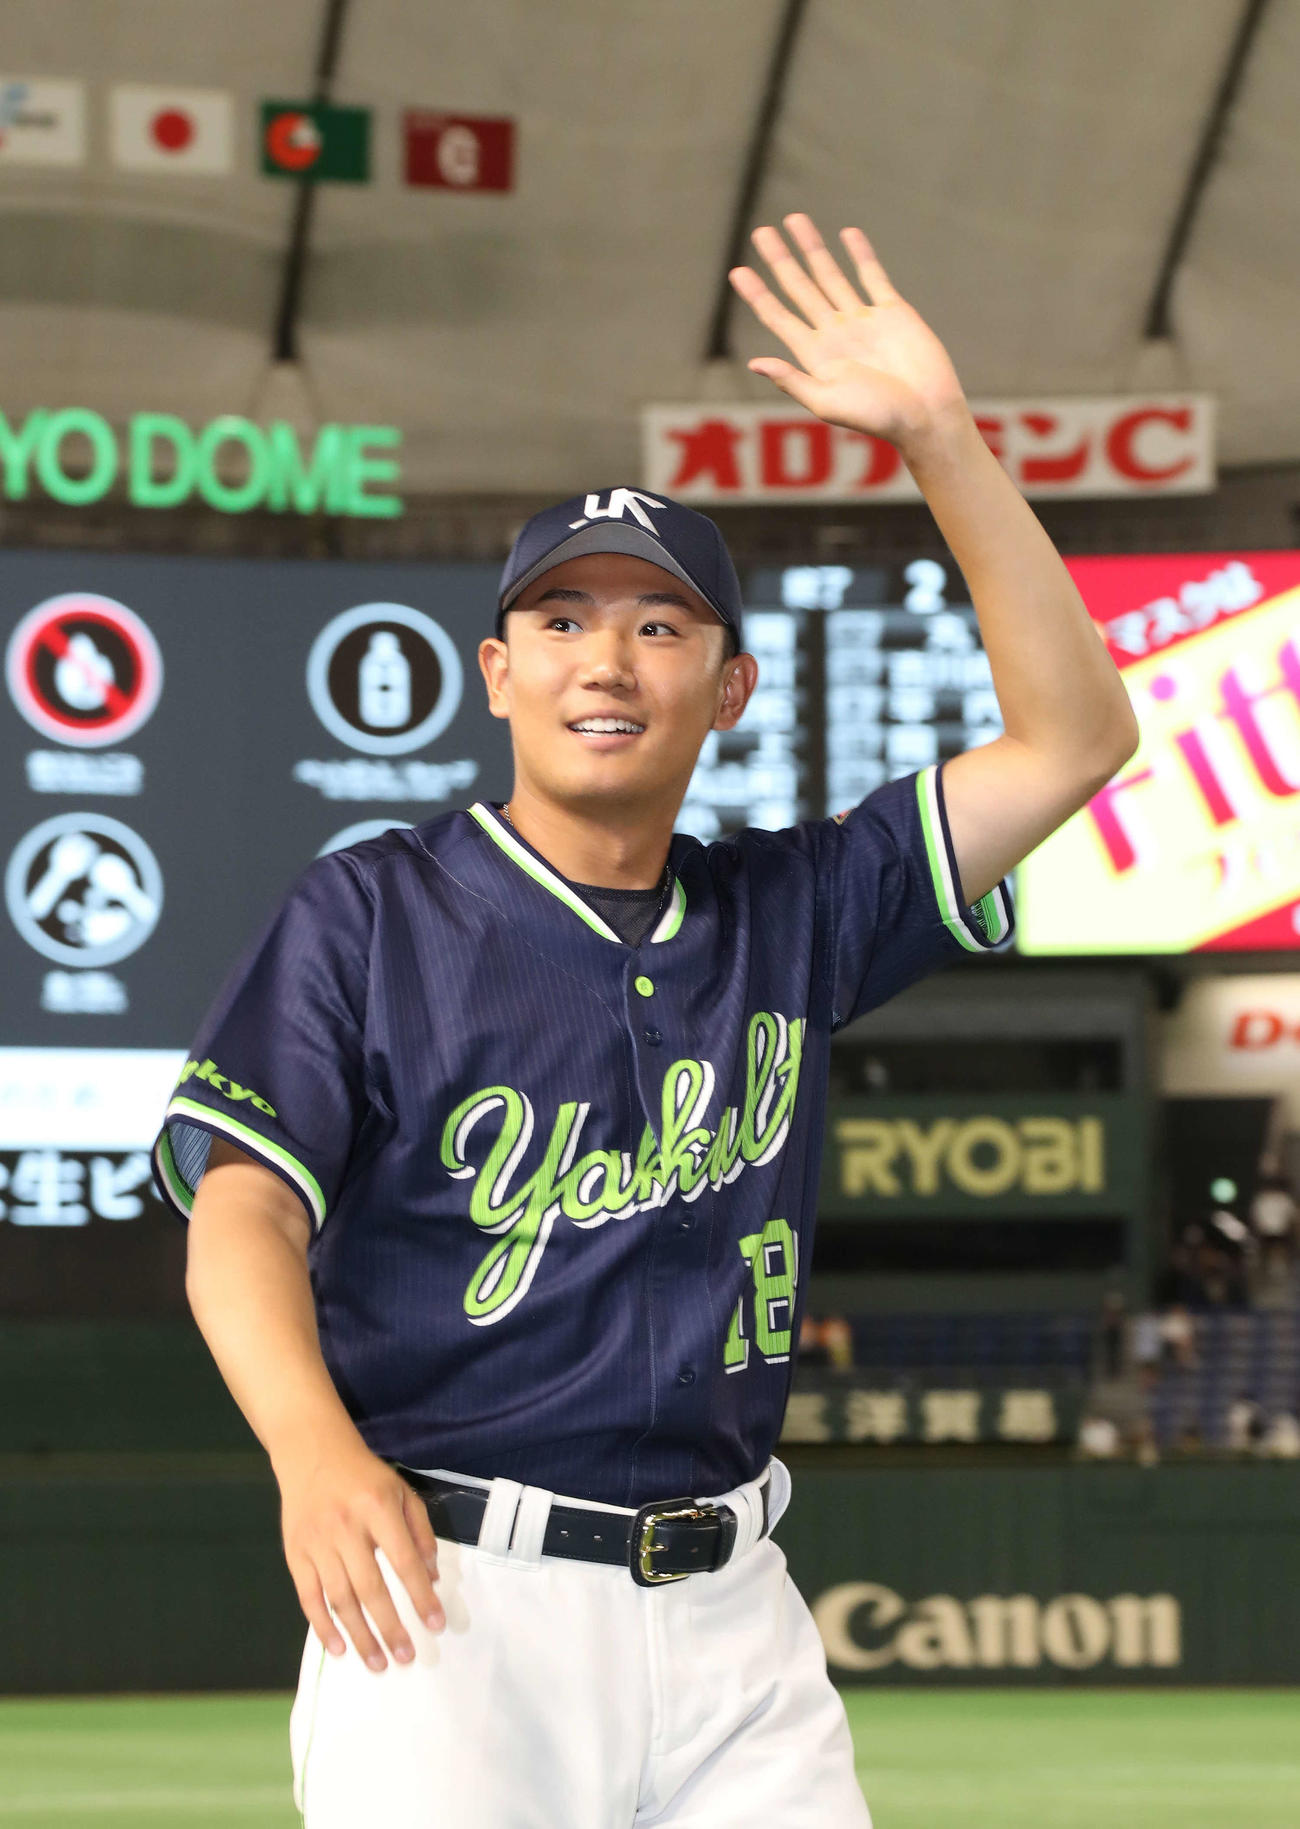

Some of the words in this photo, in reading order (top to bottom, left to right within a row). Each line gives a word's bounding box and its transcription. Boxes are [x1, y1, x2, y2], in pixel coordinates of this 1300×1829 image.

[129, 411, 404, 518] DOME
[835, 1116, 1106, 1197] RYOBI
[724, 1218, 799, 1375] 18
[811, 1580, 1182, 1671] Canon
